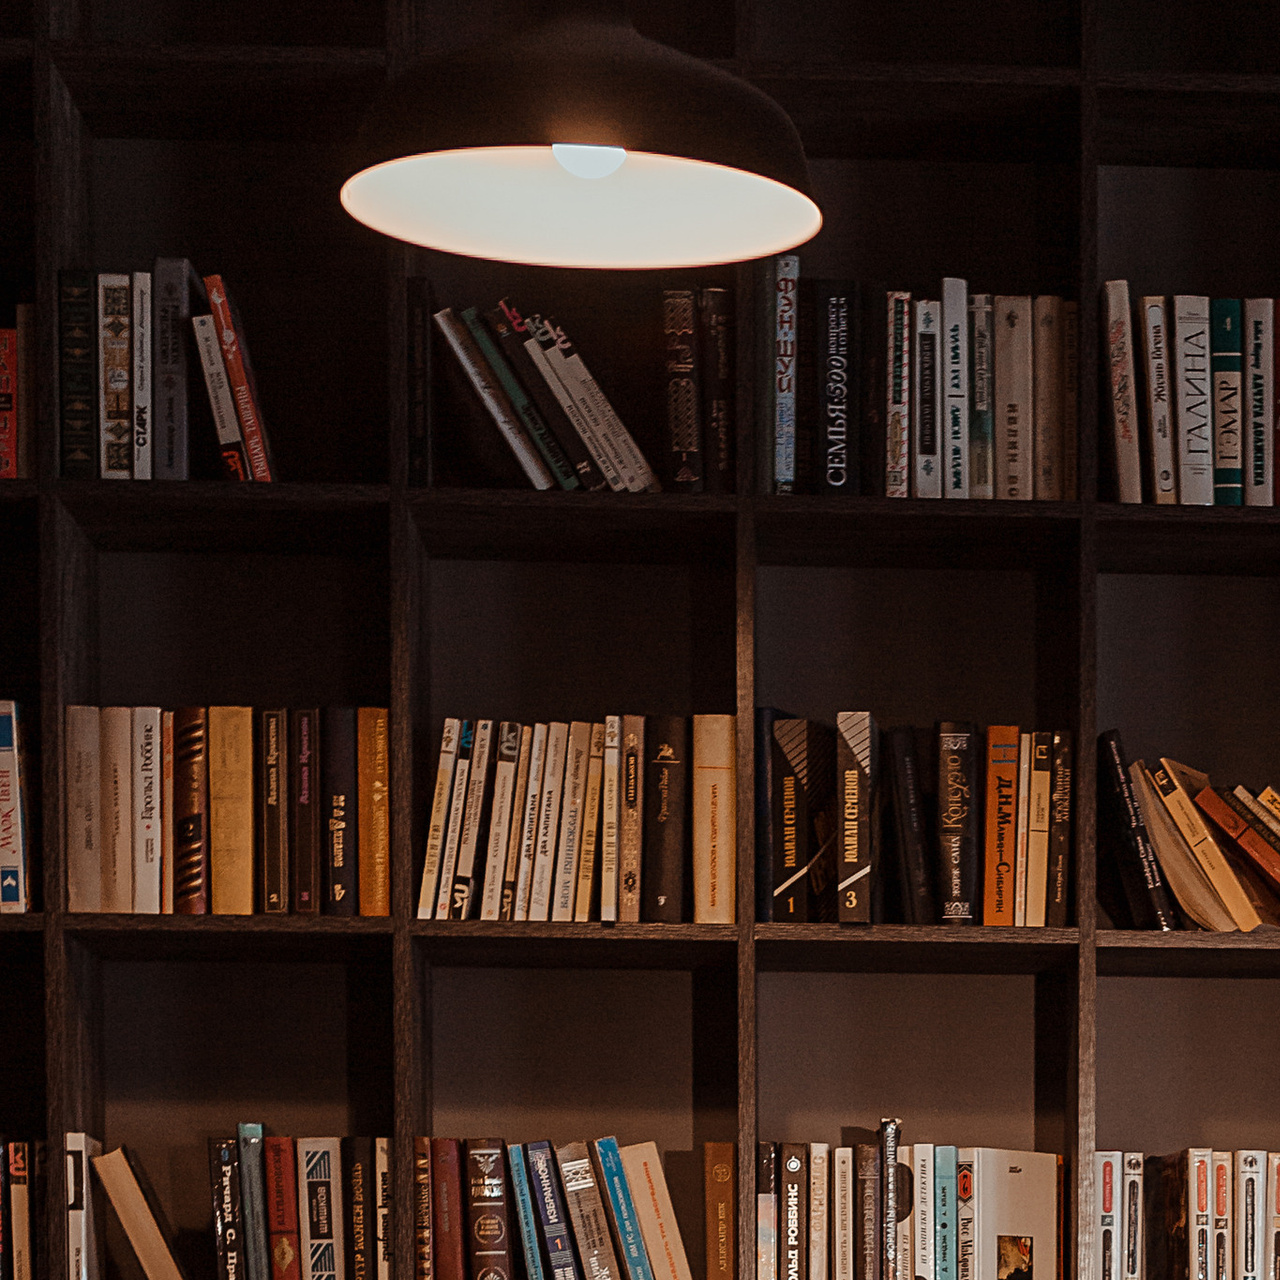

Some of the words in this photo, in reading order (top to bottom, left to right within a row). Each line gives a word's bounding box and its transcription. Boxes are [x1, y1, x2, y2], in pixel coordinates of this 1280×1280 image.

[1184, 330, 1208, 454] ГАЛИНА
[136, 406, 146, 447] СТАРК
[140, 725, 154, 772] Роббинс
[526, 794, 538, 841] КАПИТАНА
[542, 790, 554, 837] КАПИТАНА
[844, 770, 858, 819] СЕМЕНОВ
[524, 843, 532, 860] ДВА
[540, 839, 549, 856] ДВА
[845, 891, 858, 908] 3
[222, 1166, 234, 1222] Ричард
[920, 1158, 928, 1207] ДЕТЕКТИВА
[788, 1184, 798, 1245] РОББИНС
[718, 1224, 728, 1272] АЛЕКСАНДР
